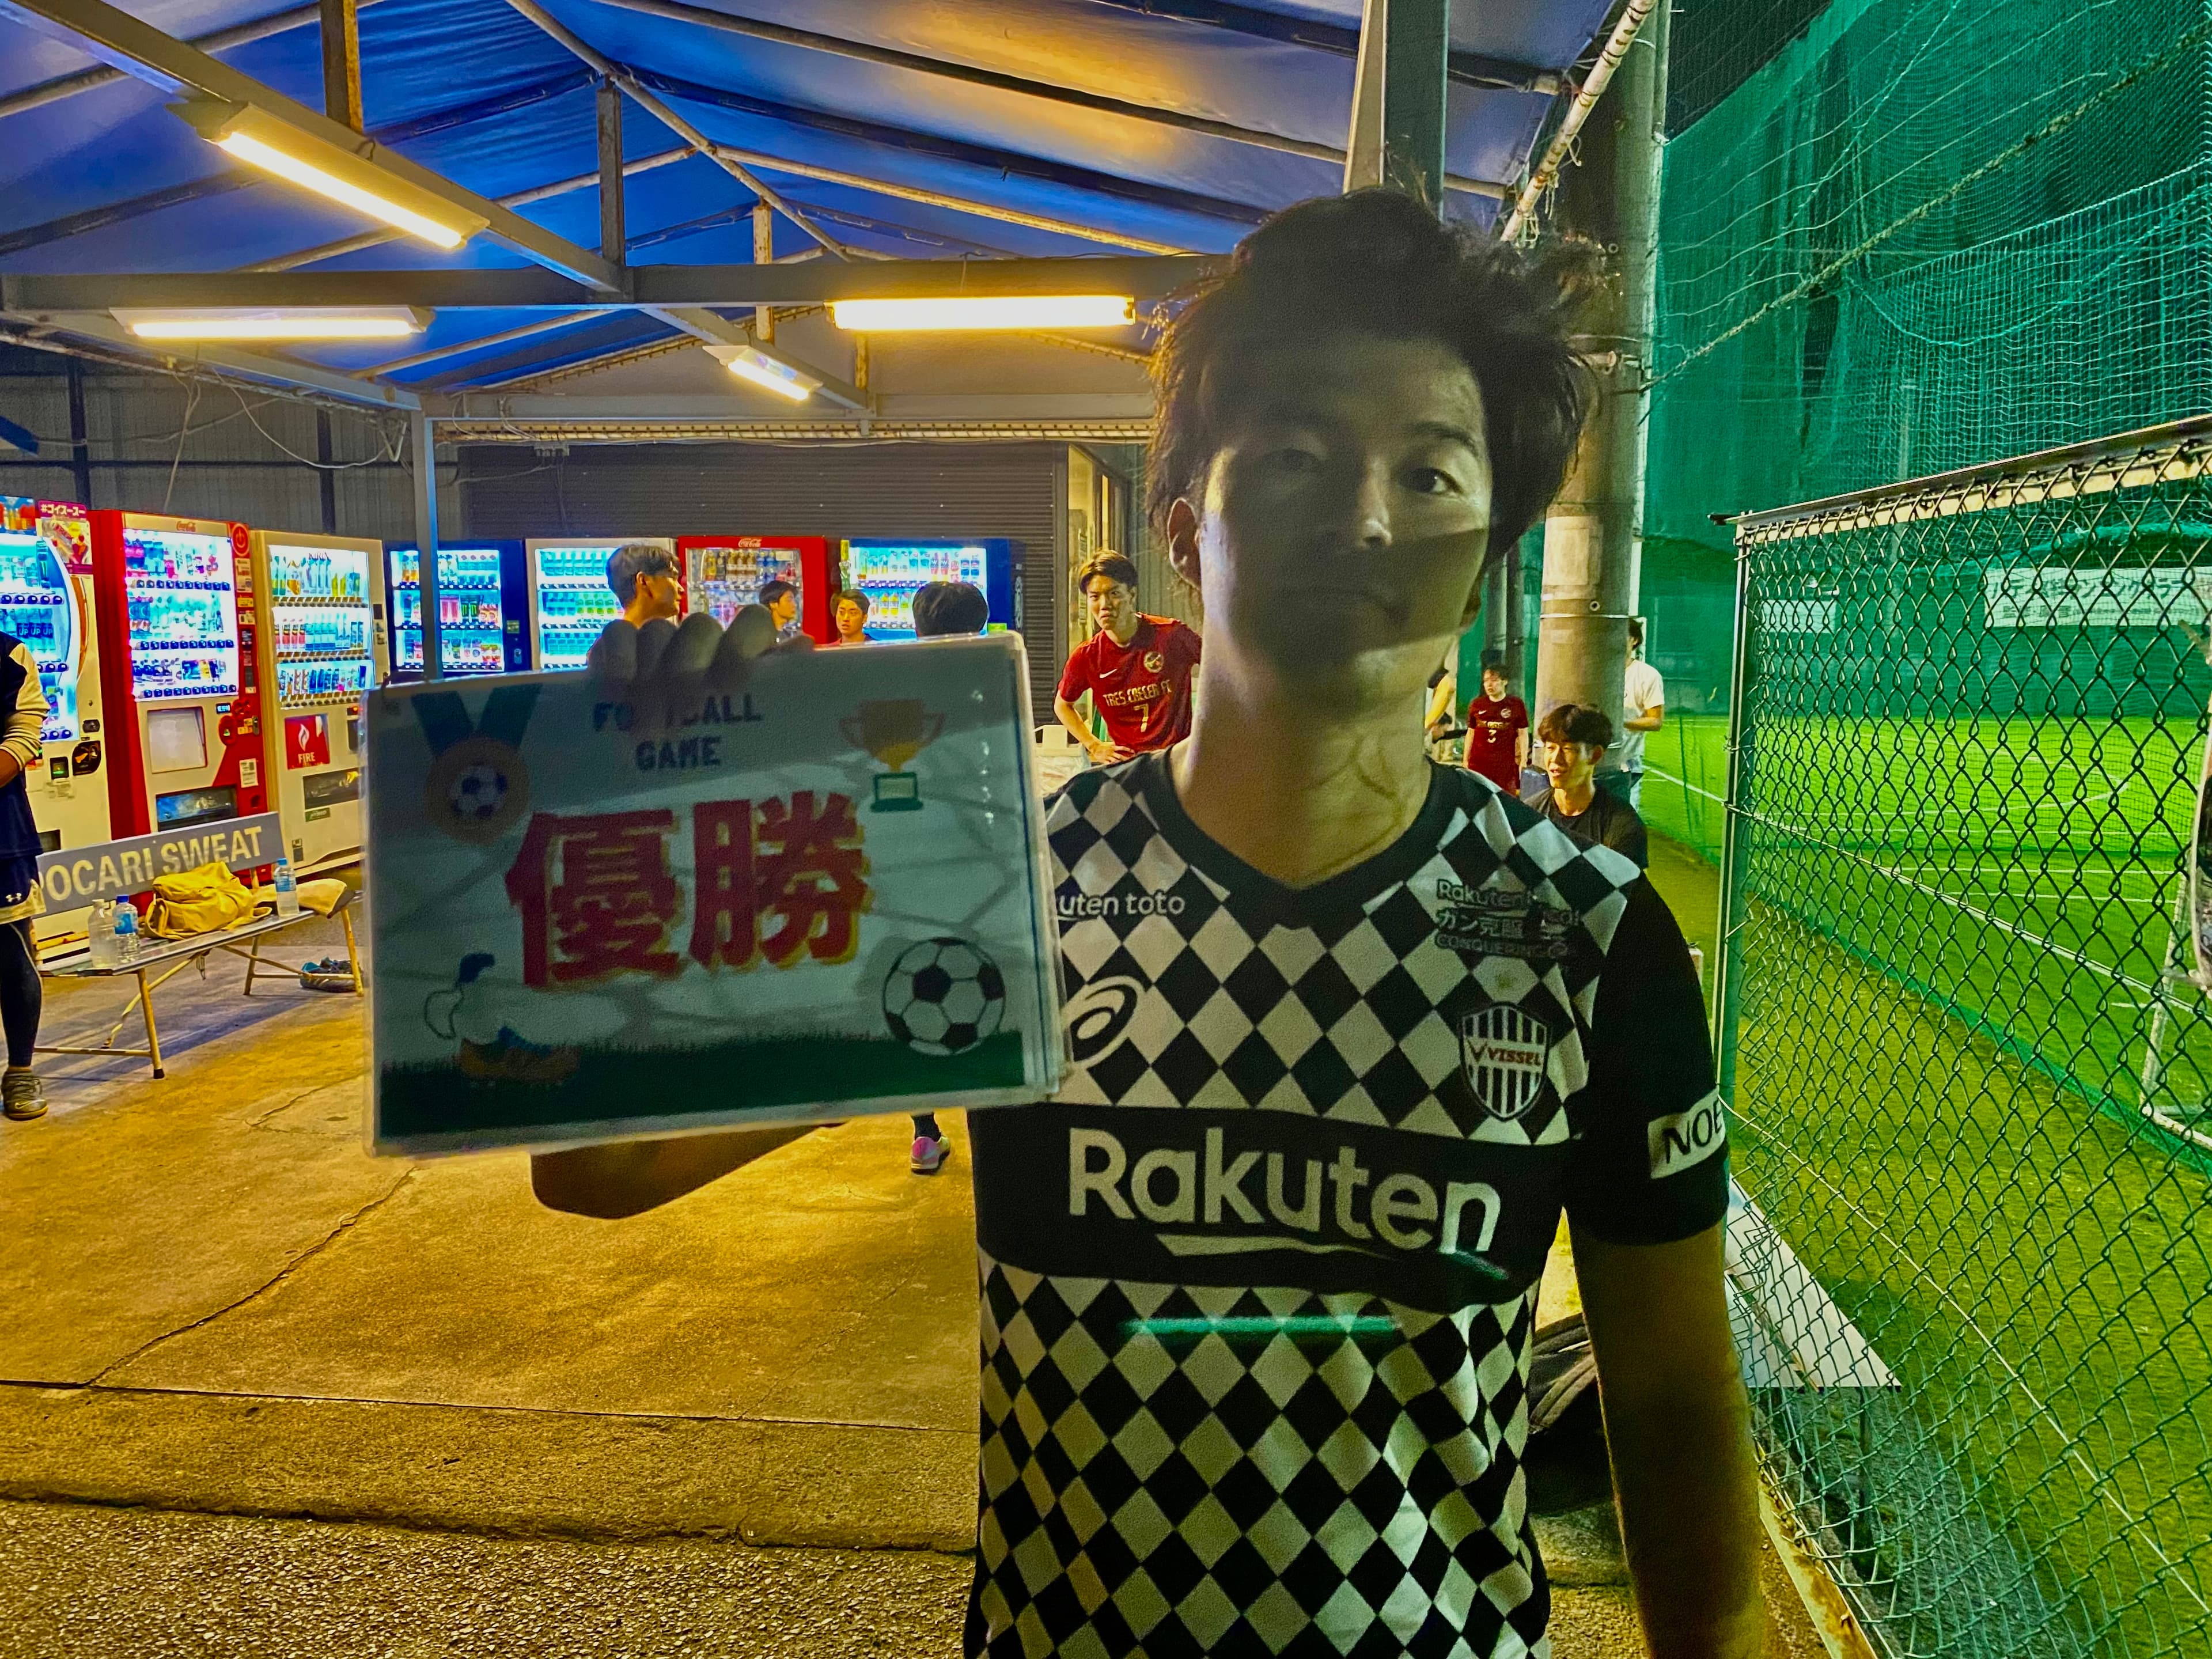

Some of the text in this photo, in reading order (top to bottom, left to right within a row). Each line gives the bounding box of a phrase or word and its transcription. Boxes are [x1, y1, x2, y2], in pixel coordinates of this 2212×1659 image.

[1133, 703, 1149, 732] 7
[1487, 729, 1497, 743] 3
[298, 752, 316, 764] FIRE
[636, 737, 721, 771] GAME
[39, 826, 262, 900] OCARI SWEAT
[505, 791, 874, 988] 優勝
[1126, 892, 1185, 915] toto
[1487, 1047, 1541, 1066] VISSEL
[1069, 1127, 1501, 1255] Rakuten
